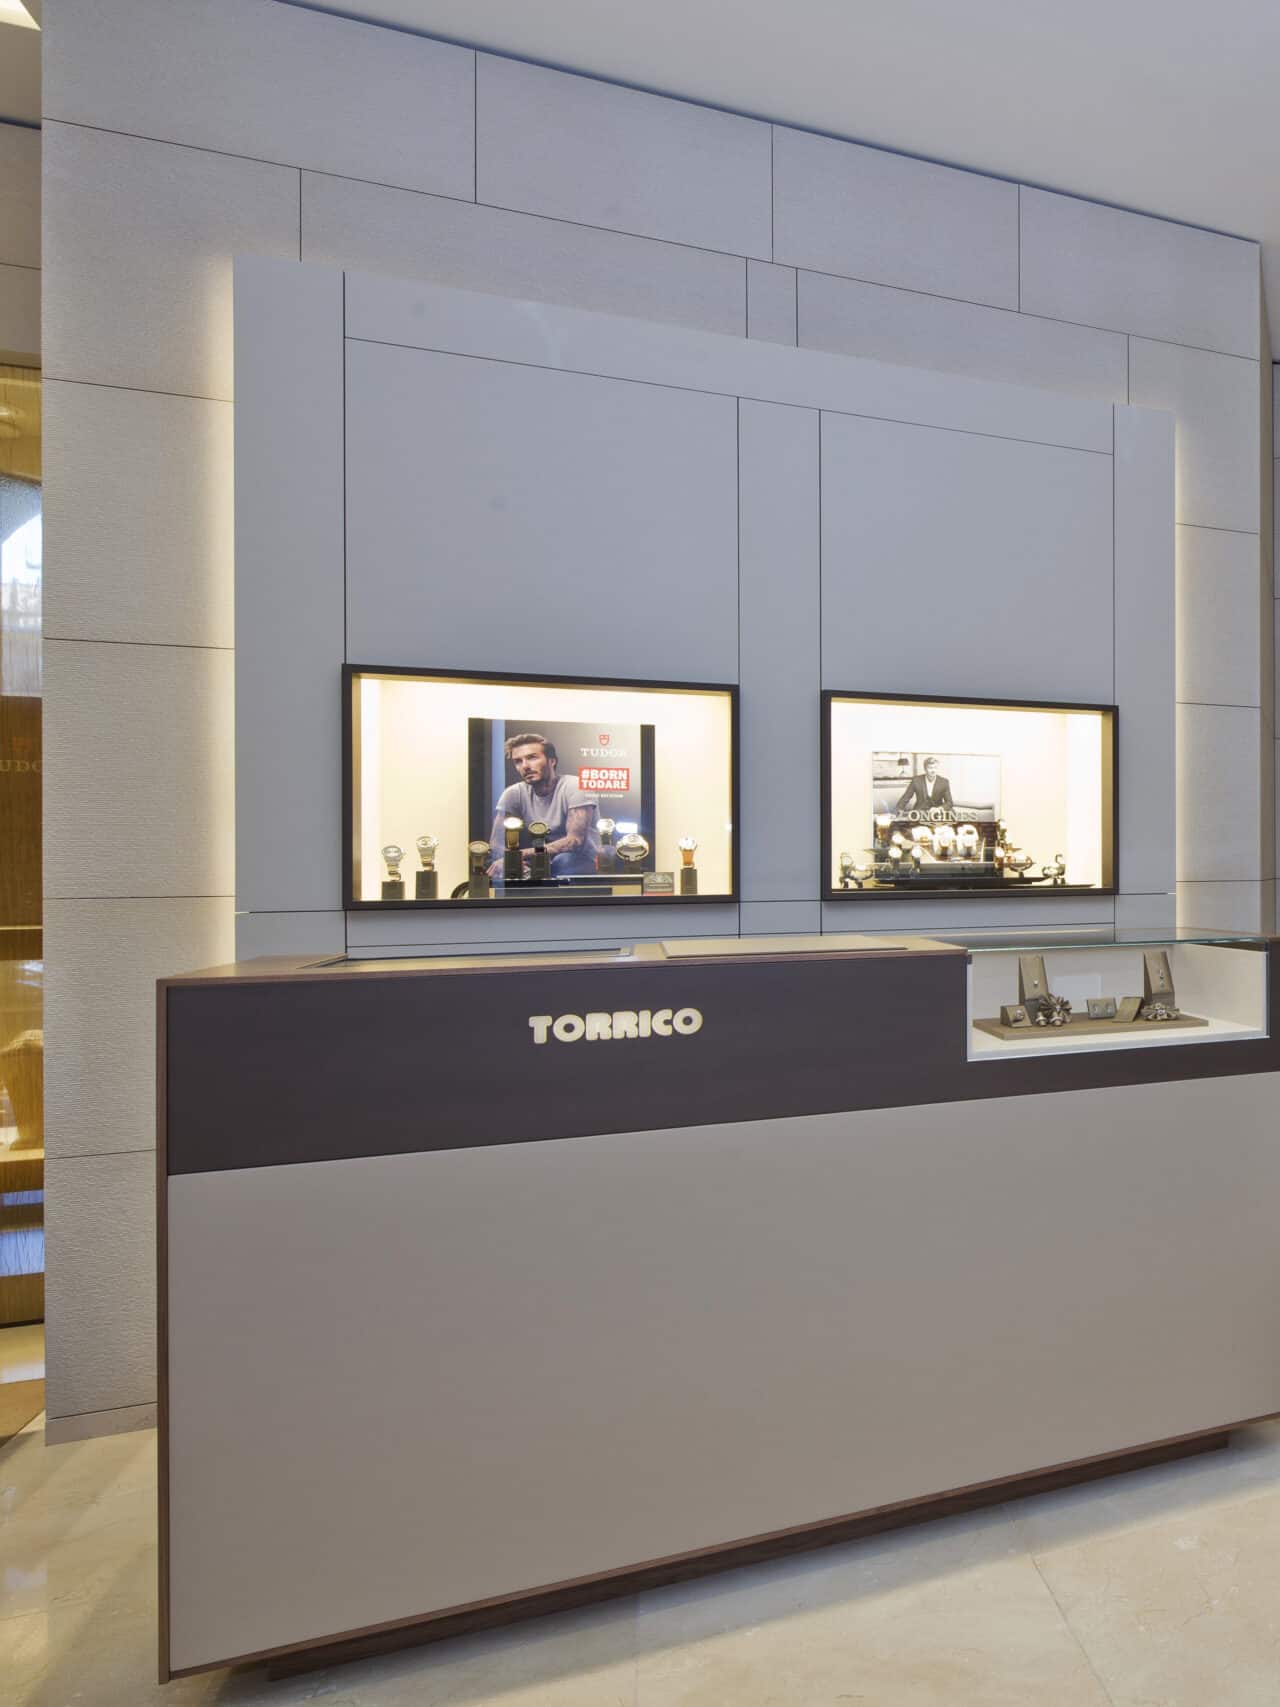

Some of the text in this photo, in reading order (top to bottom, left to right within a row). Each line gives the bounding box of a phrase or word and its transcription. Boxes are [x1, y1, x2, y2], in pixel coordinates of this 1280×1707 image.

[581, 769, 628, 780] #BORN
[581, 780, 628, 789] TODARE
[894, 809, 978, 822] LONGINES
[528, 1008, 703, 1045] TORRICO
